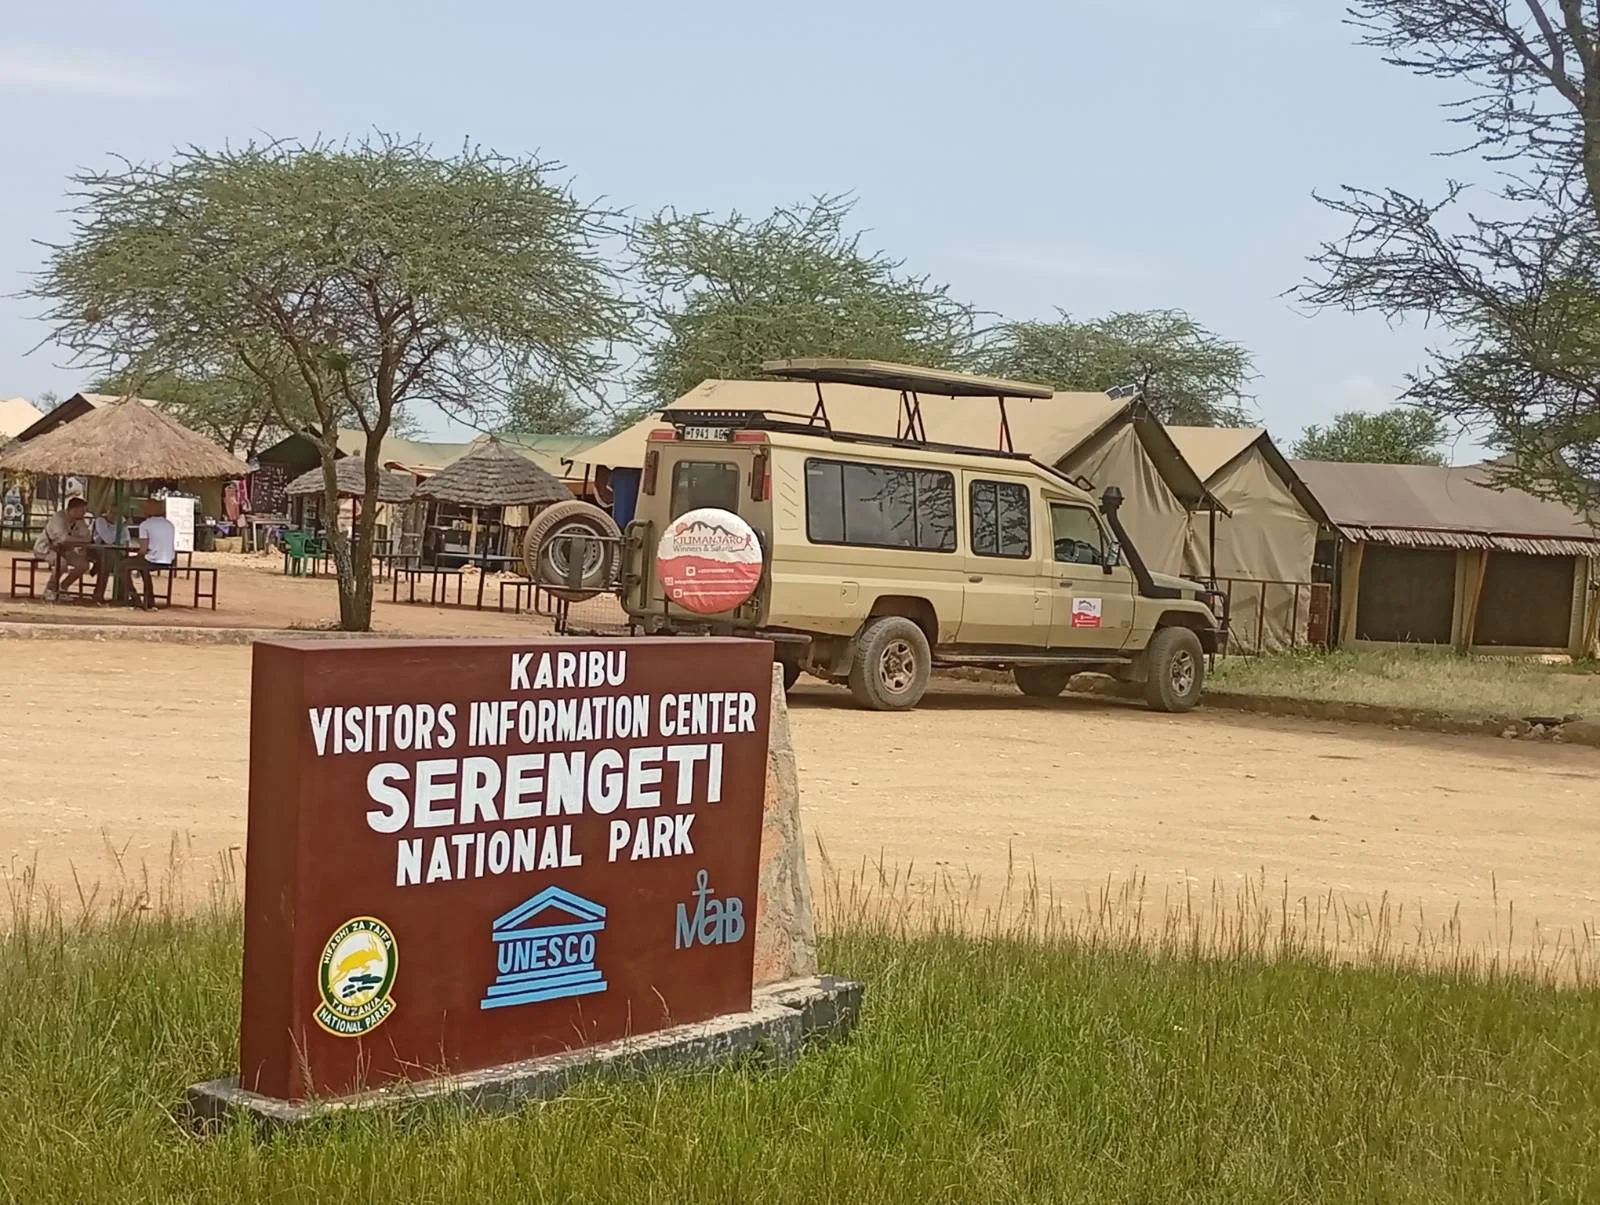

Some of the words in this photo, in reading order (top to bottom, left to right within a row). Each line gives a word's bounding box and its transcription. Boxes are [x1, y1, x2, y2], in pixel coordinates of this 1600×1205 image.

[673, 535, 743, 546] KILIMANJARO
[510, 650, 627, 690] KARIBU
[308, 703, 457, 756] VISITORS
[468, 694, 650, 747] INFORMATION
[659, 692, 756, 737] CENTER
[366, 743, 723, 834] SERENGETI
[396, 824, 583, 887] NATIONAL
[608, 813, 696, 862] PARK
[323, 928, 350, 965] HIFADHI
[351, 920, 366, 932] ZA
[368, 922, 392, 950] TAIFA
[497, 934, 596, 974] UNESCO
[318, 1007, 364, 1033] NATIONAL
[365, 1000, 392, 1029] PARKS
[330, 997, 382, 1017] TANZANIA
